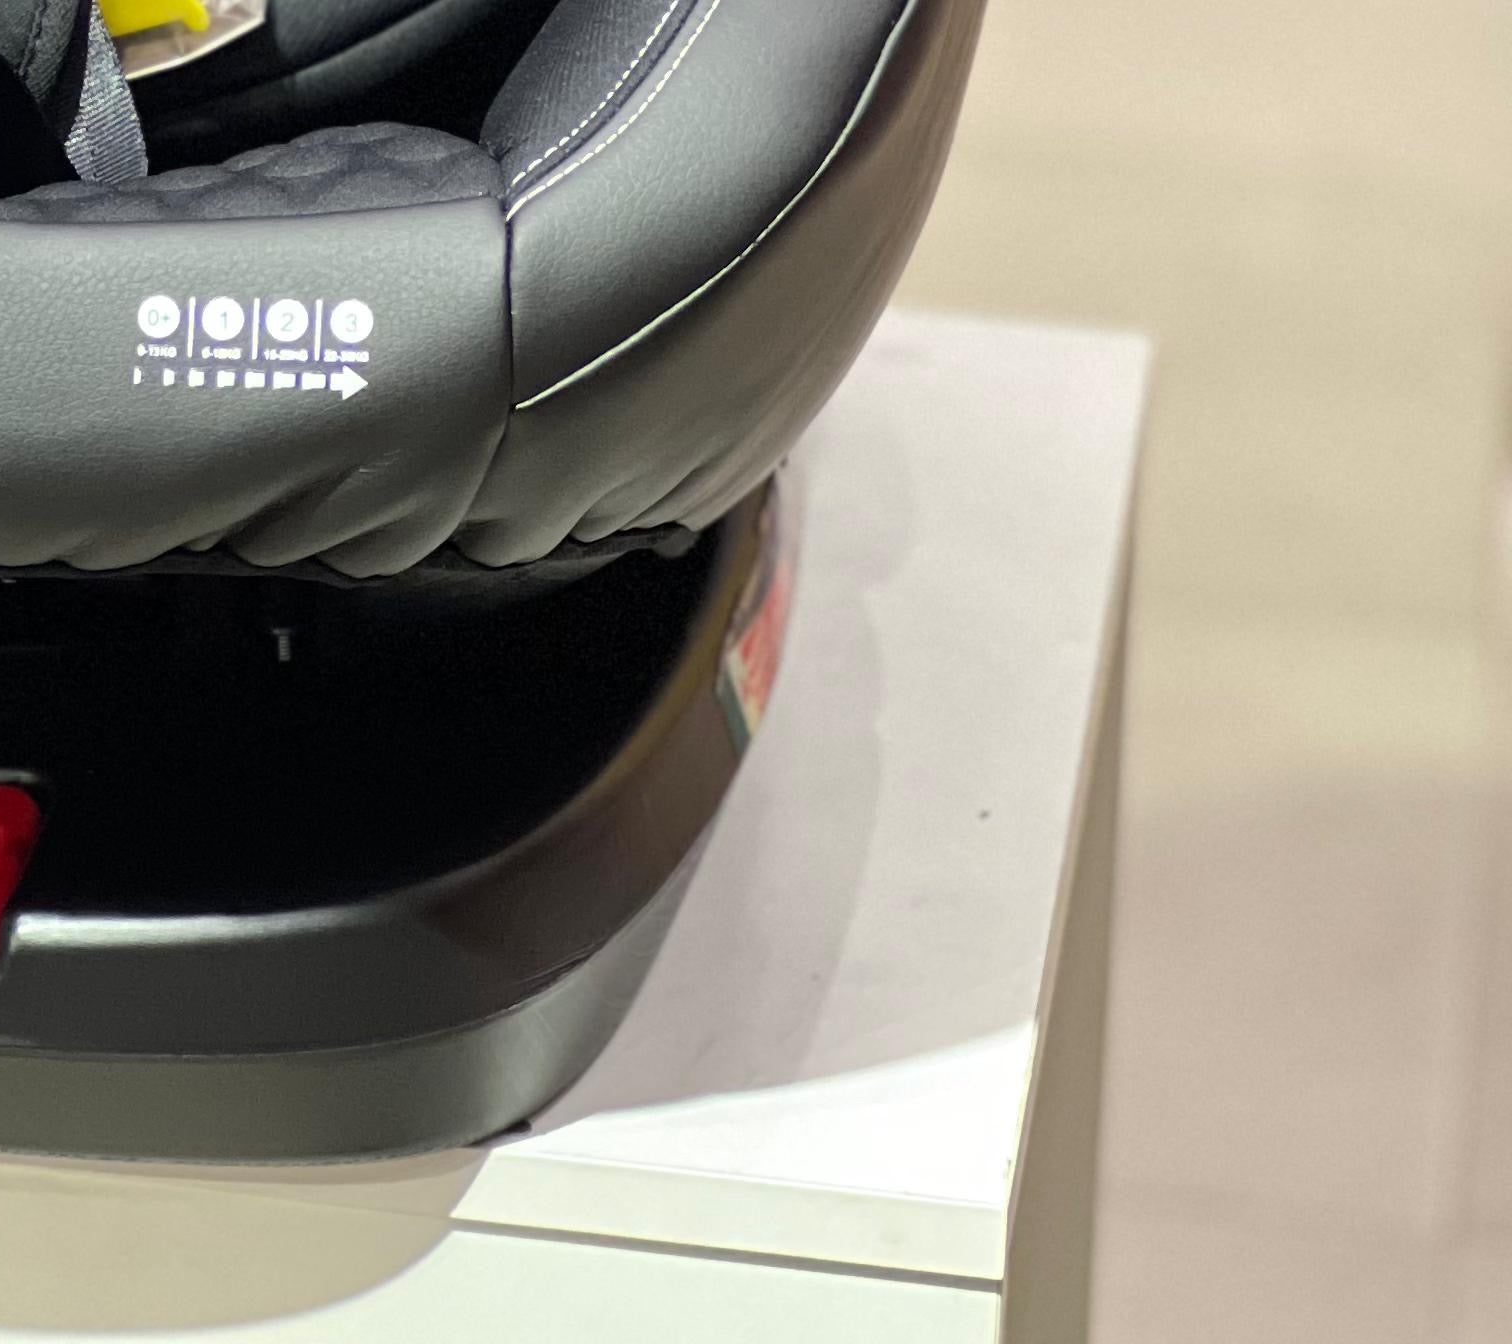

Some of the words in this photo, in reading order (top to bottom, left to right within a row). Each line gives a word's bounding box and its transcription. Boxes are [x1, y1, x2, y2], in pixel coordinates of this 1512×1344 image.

[148, 308, 171, 327] 0+
[279, 312, 295, 333] 2
[344, 312, 359, 333] 3
